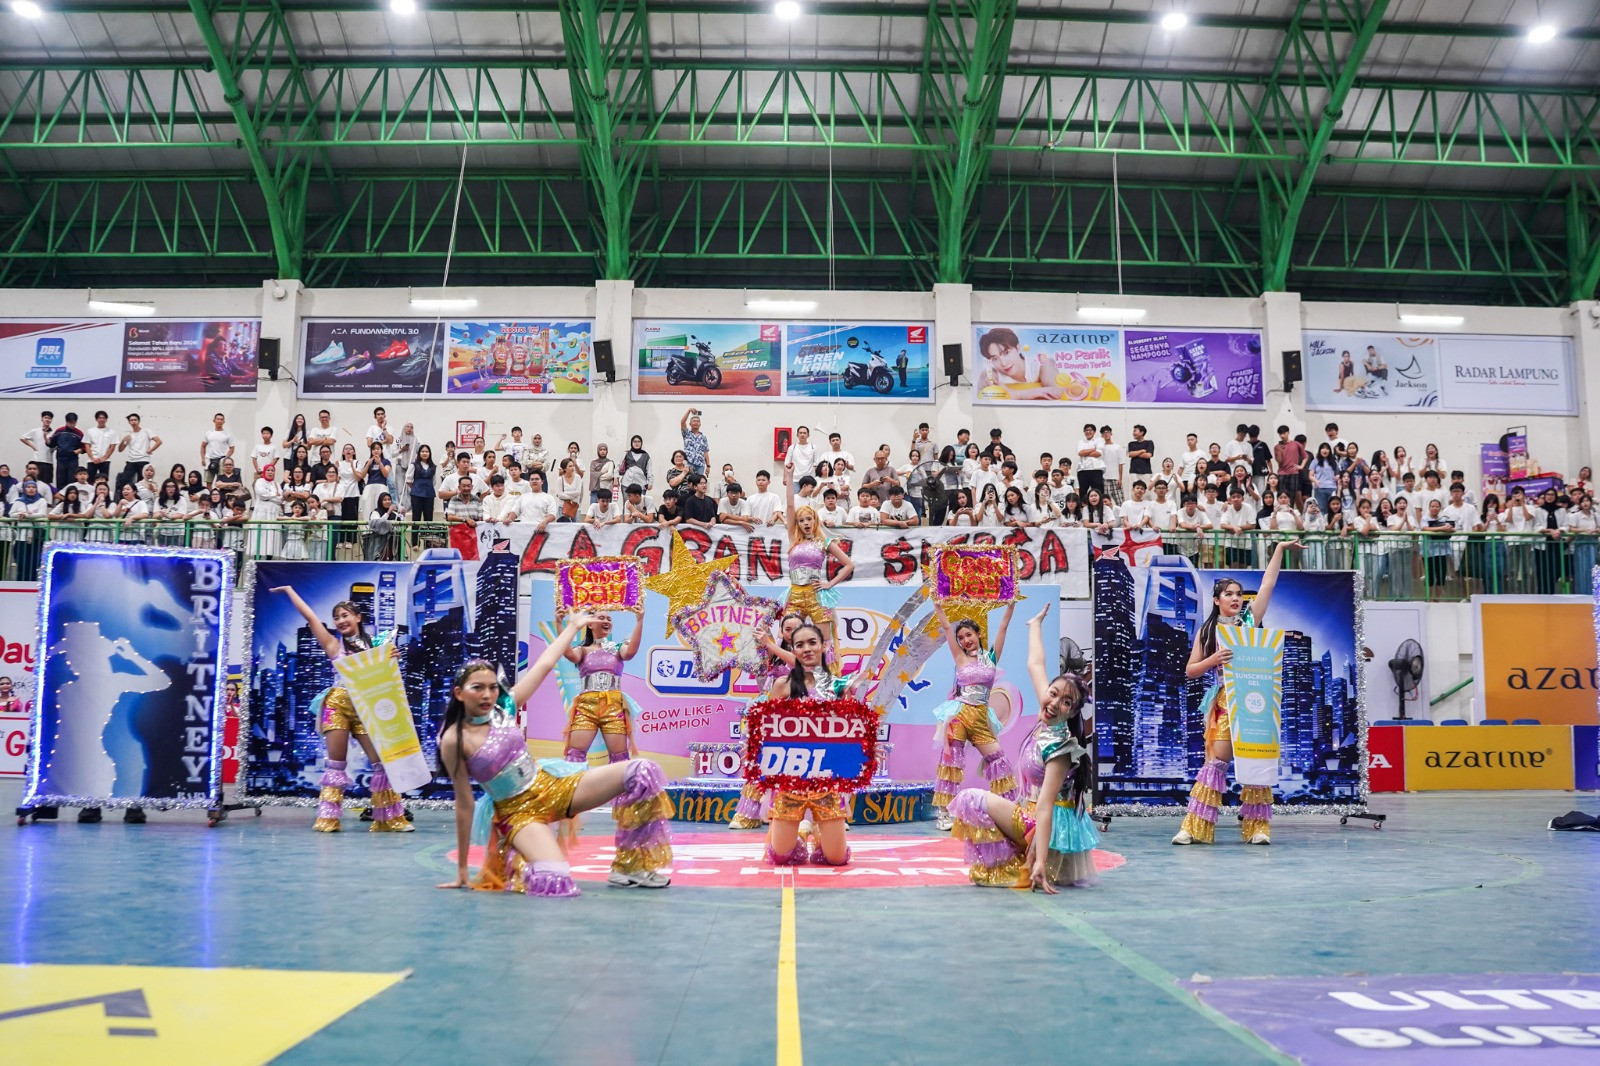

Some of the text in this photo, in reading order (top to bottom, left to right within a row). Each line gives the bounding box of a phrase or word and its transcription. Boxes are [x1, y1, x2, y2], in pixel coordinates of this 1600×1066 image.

[1037, 333, 1110, 344] azarine
[39, 345, 61, 355] DBL
[793, 351, 845, 365] KEREN
[1055, 348, 1111, 361] No Panik
[1130, 342, 1170, 355] SEGERNYA
[732, 361, 768, 370] BENER
[1455, 366, 1559, 380] RADAR LAMPUNG
[1227, 374, 1259, 387] MOVE
[520, 525, 598, 575] LA
[941, 549, 1010, 576] Good
[568, 563, 627, 585] Good
[573, 584, 627, 606] Day
[949, 575, 1001, 599] Day
[684, 605, 765, 636] BRITNEY
[184, 559, 223, 783] BRITNEY
[1234, 672, 1273, 681] SUNSCREEN
[641, 703, 725, 722] GLOW LIKE A
[1251, 699, 1262, 707] 45
[641, 717, 710, 733] CHAMPION
[761, 713, 866, 739] HONDA
[759, 746, 834, 778] DBL
[863, 791, 920, 823] Star
[1334, 1024, 1600, 1049] BLUE
